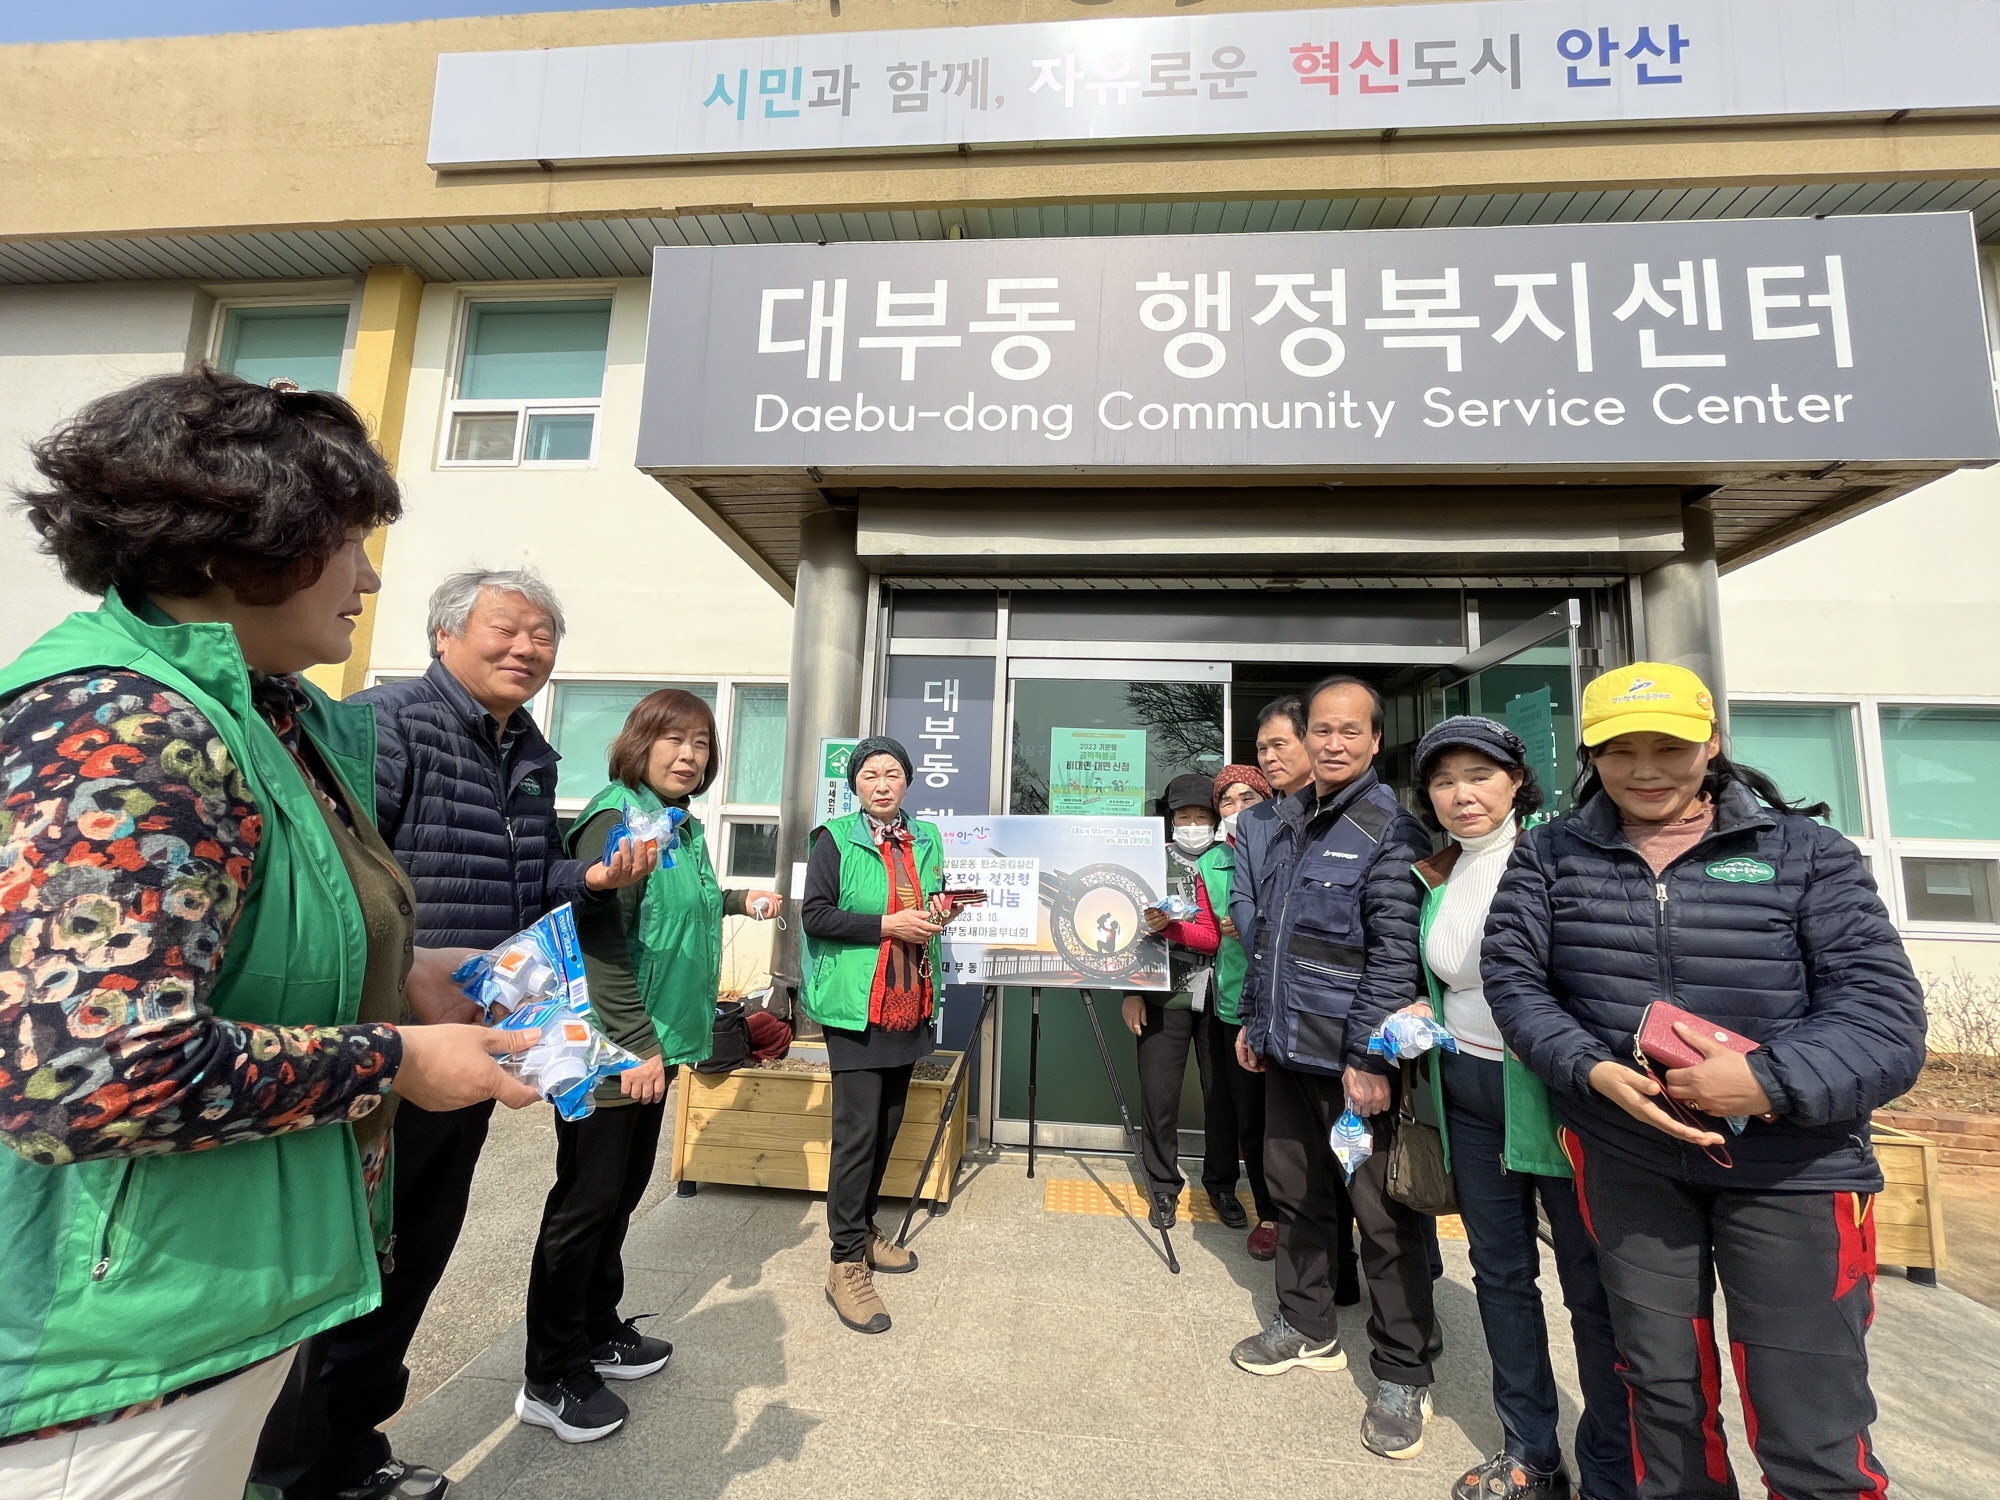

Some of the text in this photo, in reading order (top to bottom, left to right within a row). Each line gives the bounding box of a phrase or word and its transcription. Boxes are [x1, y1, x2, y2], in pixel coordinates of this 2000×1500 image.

[703, 24, 1690, 121] 시민과 함께, 자유로운 혁신도시 안산
[756, 254, 1855, 383] 대부동 행정복지센터
[754, 383, 1853, 442] Daebu-dong Community Service Center
[916, 678, 960, 789] 대부동
[1112, 761, 1130, 772] 신청
[981, 859, 1034, 869] 탄소중립실천
[989, 872, 1030, 886] 절전형
[990, 888, 1020, 908] 나눔
[988, 912, 999, 922] 10.
